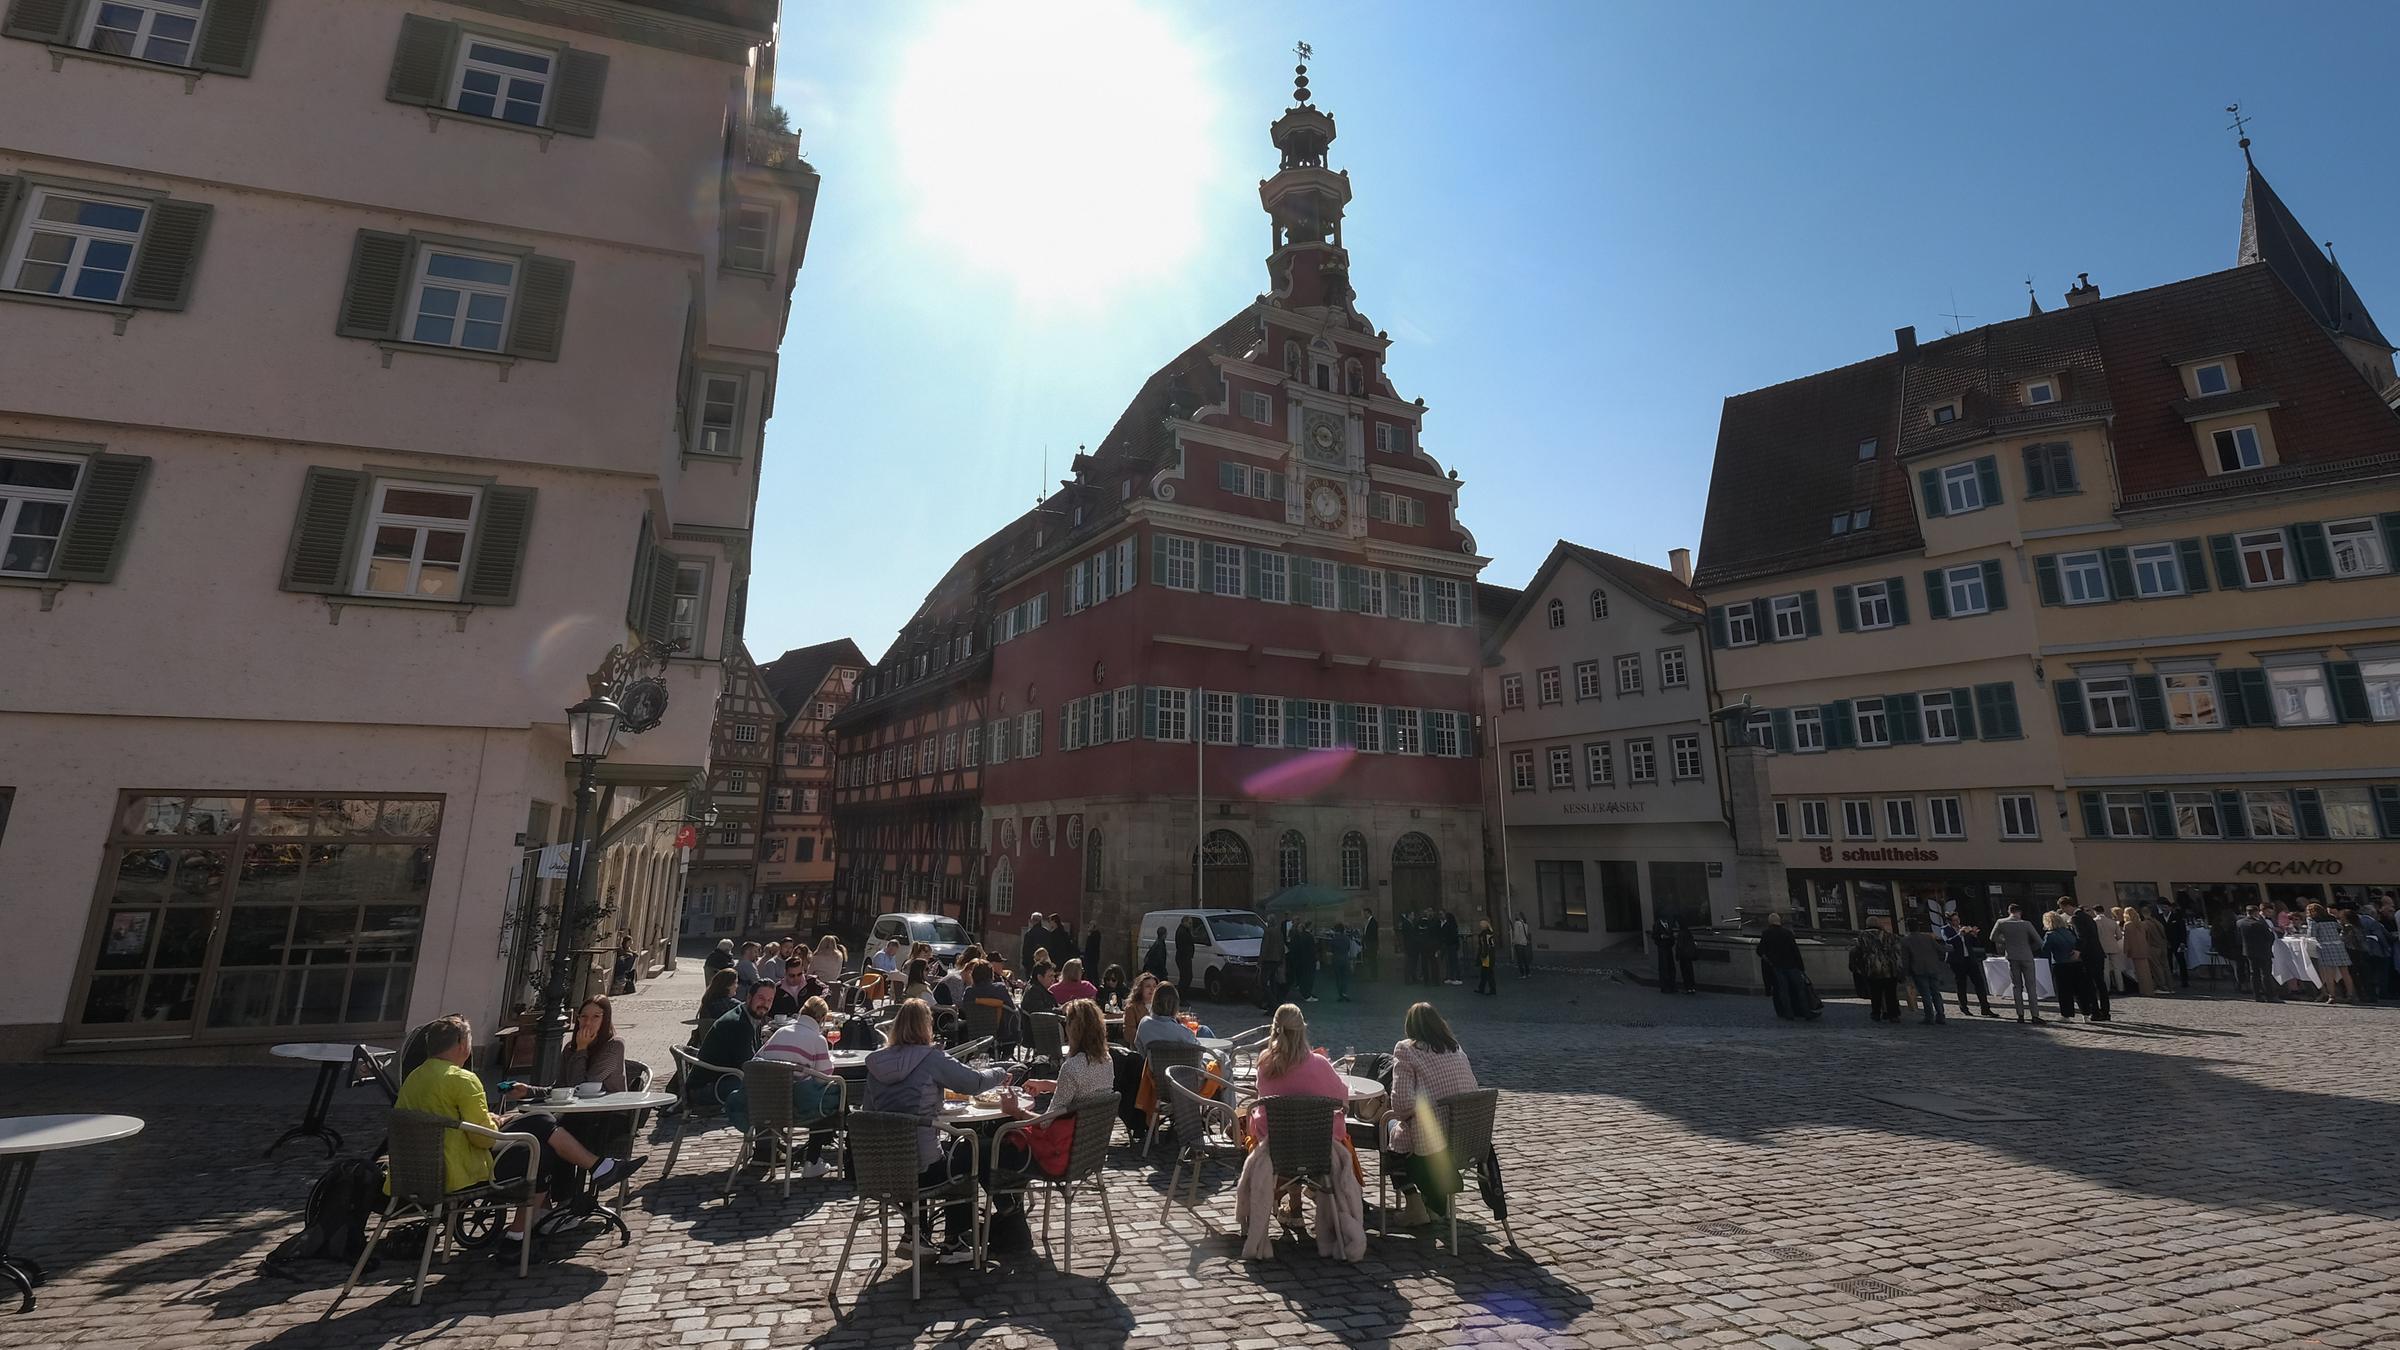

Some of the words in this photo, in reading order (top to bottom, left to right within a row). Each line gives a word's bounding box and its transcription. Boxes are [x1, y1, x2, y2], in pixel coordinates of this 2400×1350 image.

[1563, 802, 1605, 814] KESSLER
[1620, 801, 1645, 813] SEKT
[1842, 847, 1939, 862] schultheiss
[2236, 859, 2343, 875] ACCANTO
